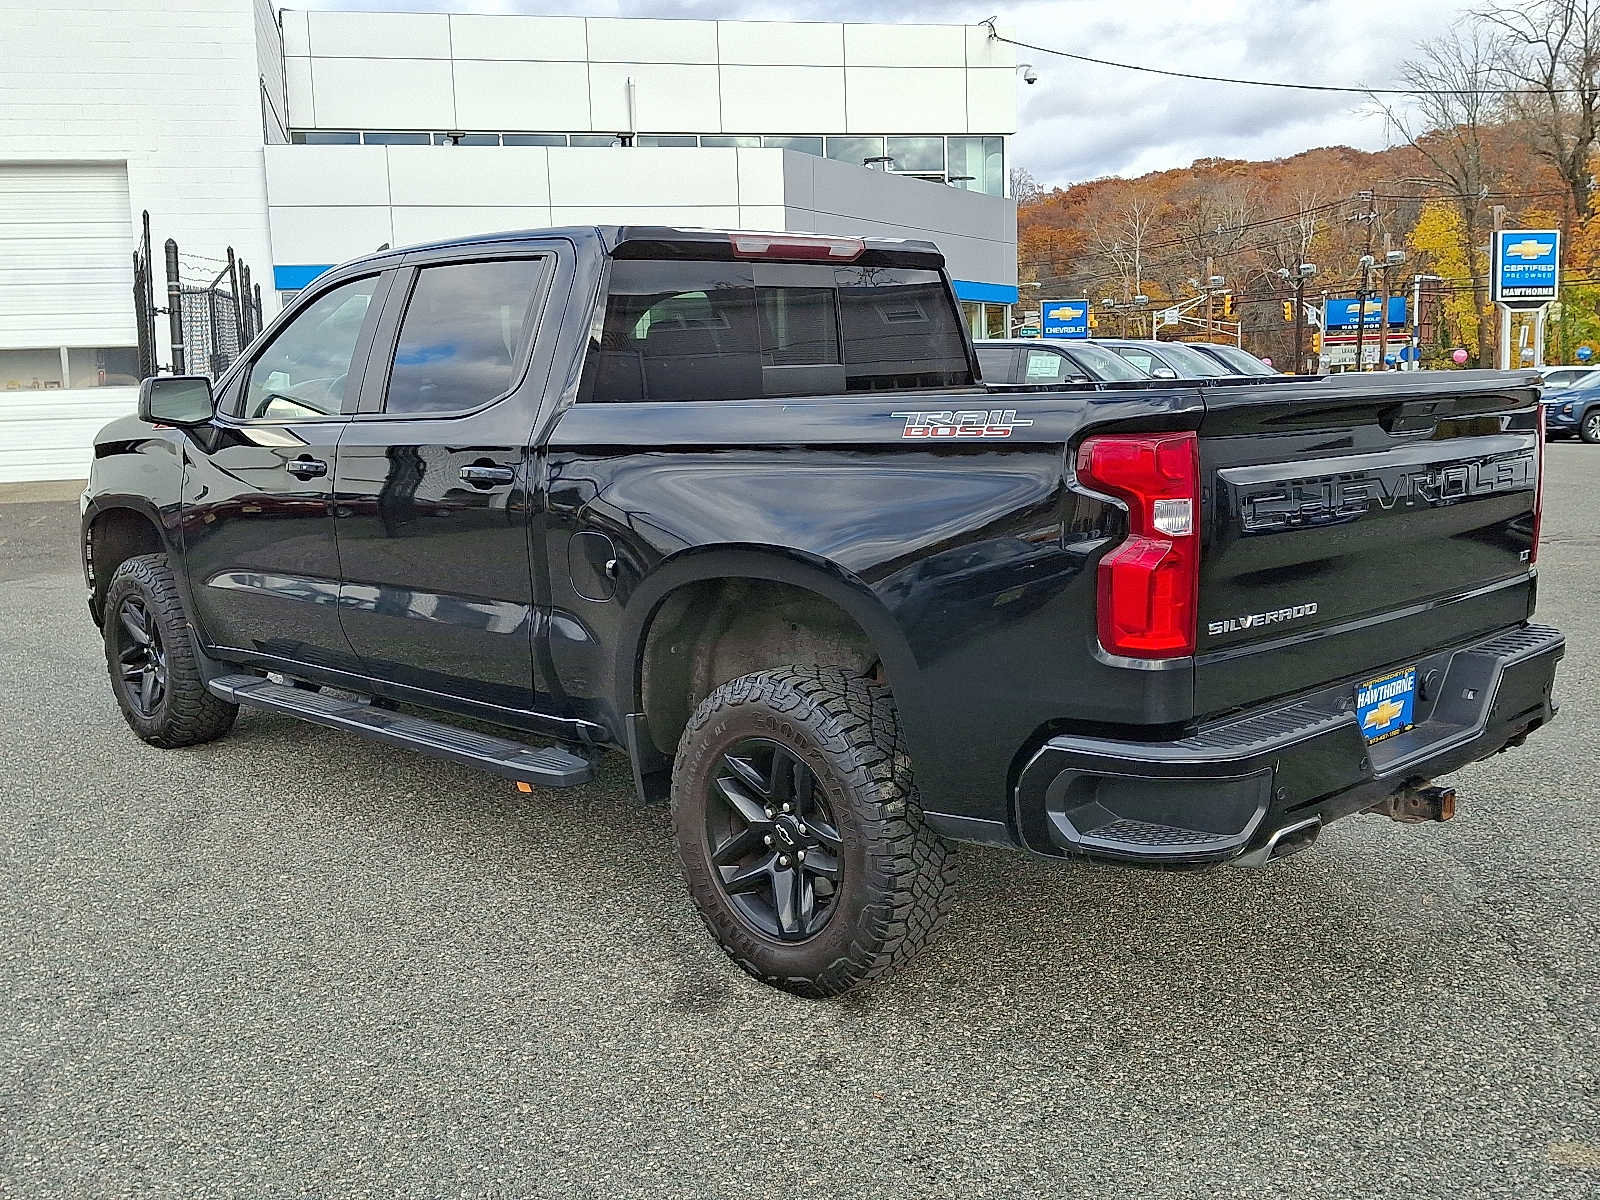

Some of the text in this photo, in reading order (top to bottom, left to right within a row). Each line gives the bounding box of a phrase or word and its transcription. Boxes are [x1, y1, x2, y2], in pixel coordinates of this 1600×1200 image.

[1504, 264, 1554, 272] CERTIFIED
[1502, 287, 1553, 297] HAWTHORNE
[1045, 326, 1087, 334] CHEVROLET
[890, 409, 1034, 426] TRAIL
[901, 425, 1013, 439] BOSS
[1241, 453, 1534, 533] CHEVROLET
[1208, 602, 1318, 636] SILVERADO
[1356, 675, 1414, 709] HAWTHORNE
